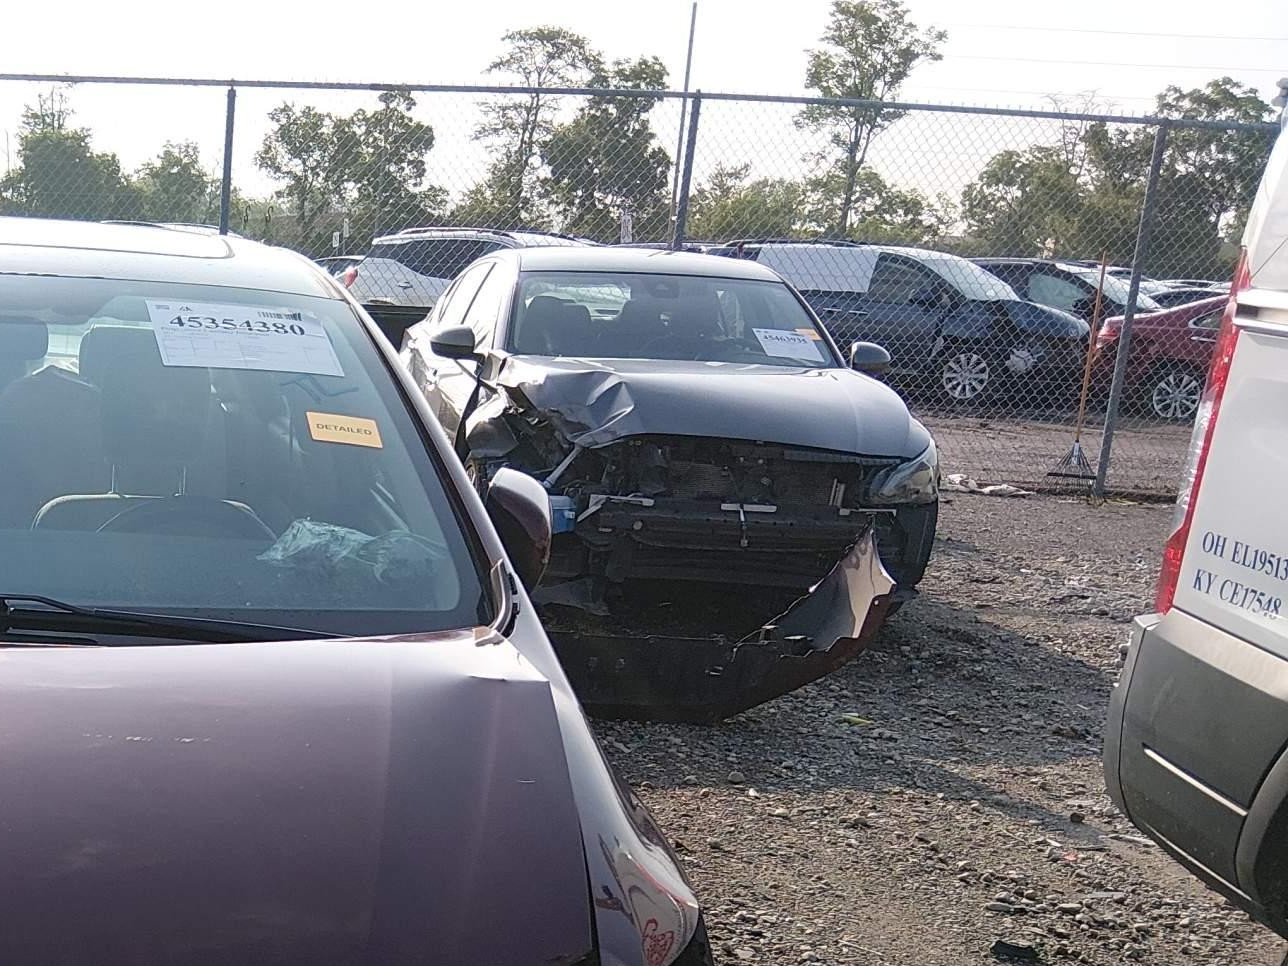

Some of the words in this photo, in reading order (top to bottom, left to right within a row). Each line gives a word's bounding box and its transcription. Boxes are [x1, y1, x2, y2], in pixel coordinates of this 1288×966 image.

[169, 315, 305, 336] 45354380
[315, 422, 373, 436] DETAILED
[1202, 531, 1227, 558] OH
[1193, 568, 1218, 594] KY
[1219, 579, 1282, 618] CE17548
